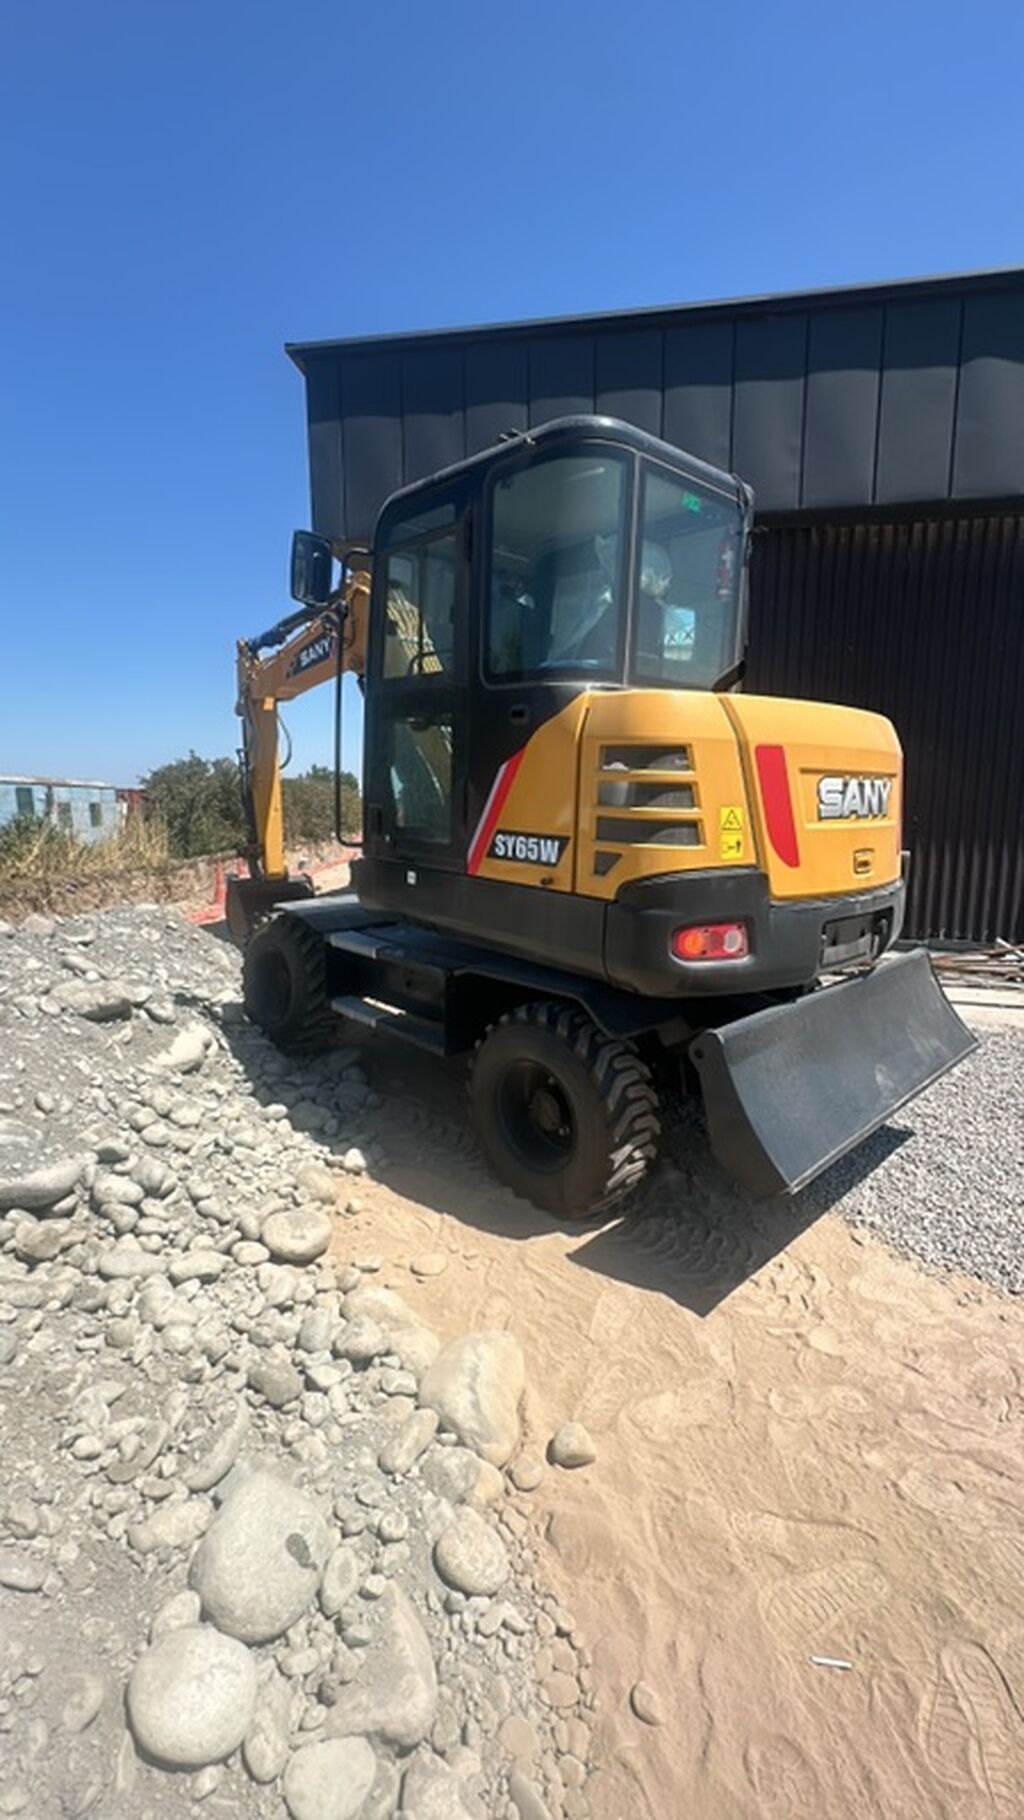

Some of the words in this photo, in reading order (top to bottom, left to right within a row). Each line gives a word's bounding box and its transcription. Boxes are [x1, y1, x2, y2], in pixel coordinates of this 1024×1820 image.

[300, 637, 331, 667] SANY
[818, 776, 892, 819] SANY
[494, 833, 559, 864] SY65W
